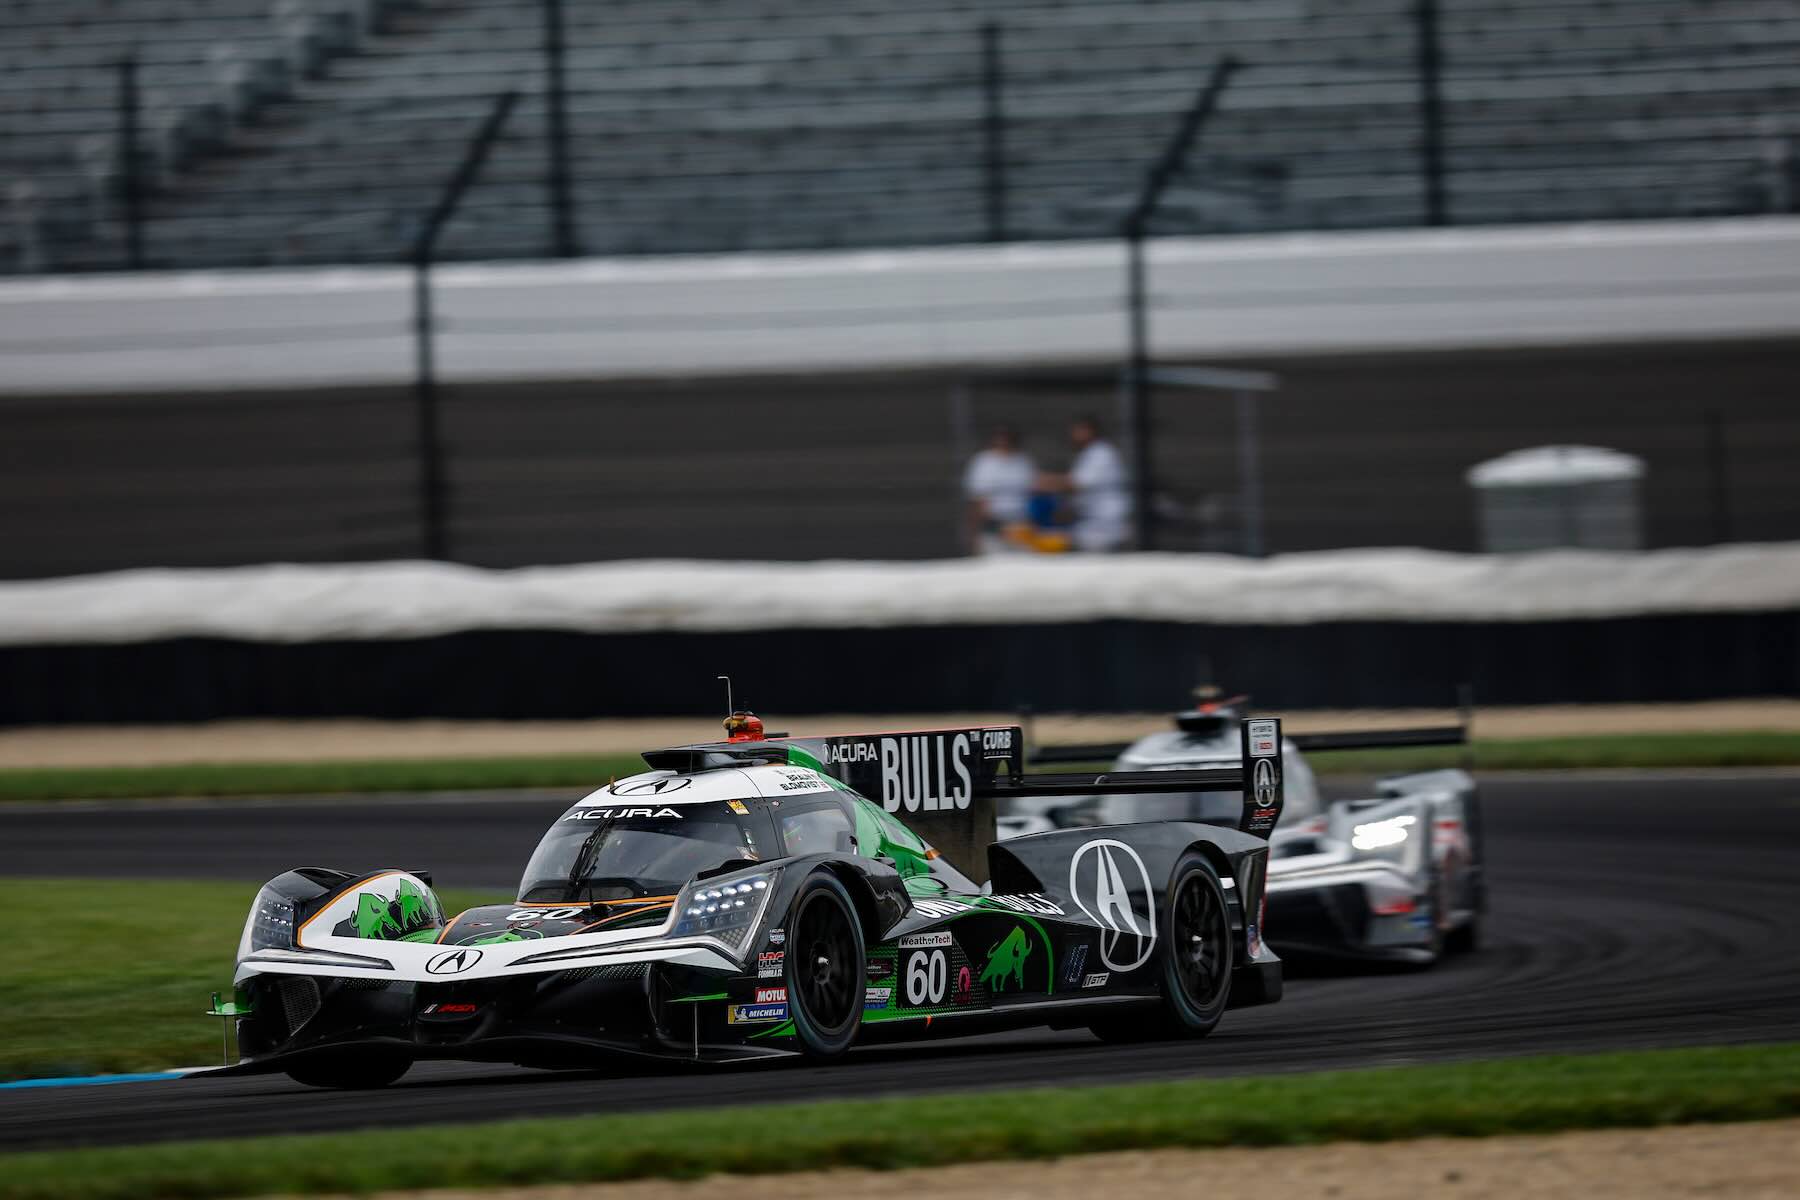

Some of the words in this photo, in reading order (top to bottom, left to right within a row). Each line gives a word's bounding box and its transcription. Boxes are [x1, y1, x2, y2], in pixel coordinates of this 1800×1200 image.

[983, 731, 1012, 750] CURB
[830, 743, 878, 763] ACURA
[881, 733, 972, 813] BULLS
[563, 807, 683, 822] ACURA
[506, 908, 583, 921] 60
[901, 935, 951, 946] WeatherTech
[758, 951, 785, 968] HRC
[906, 949, 947, 1005] 60
[757, 989, 787, 1002] MOTUL
[748, 1008, 785, 1018] MICHELIN
